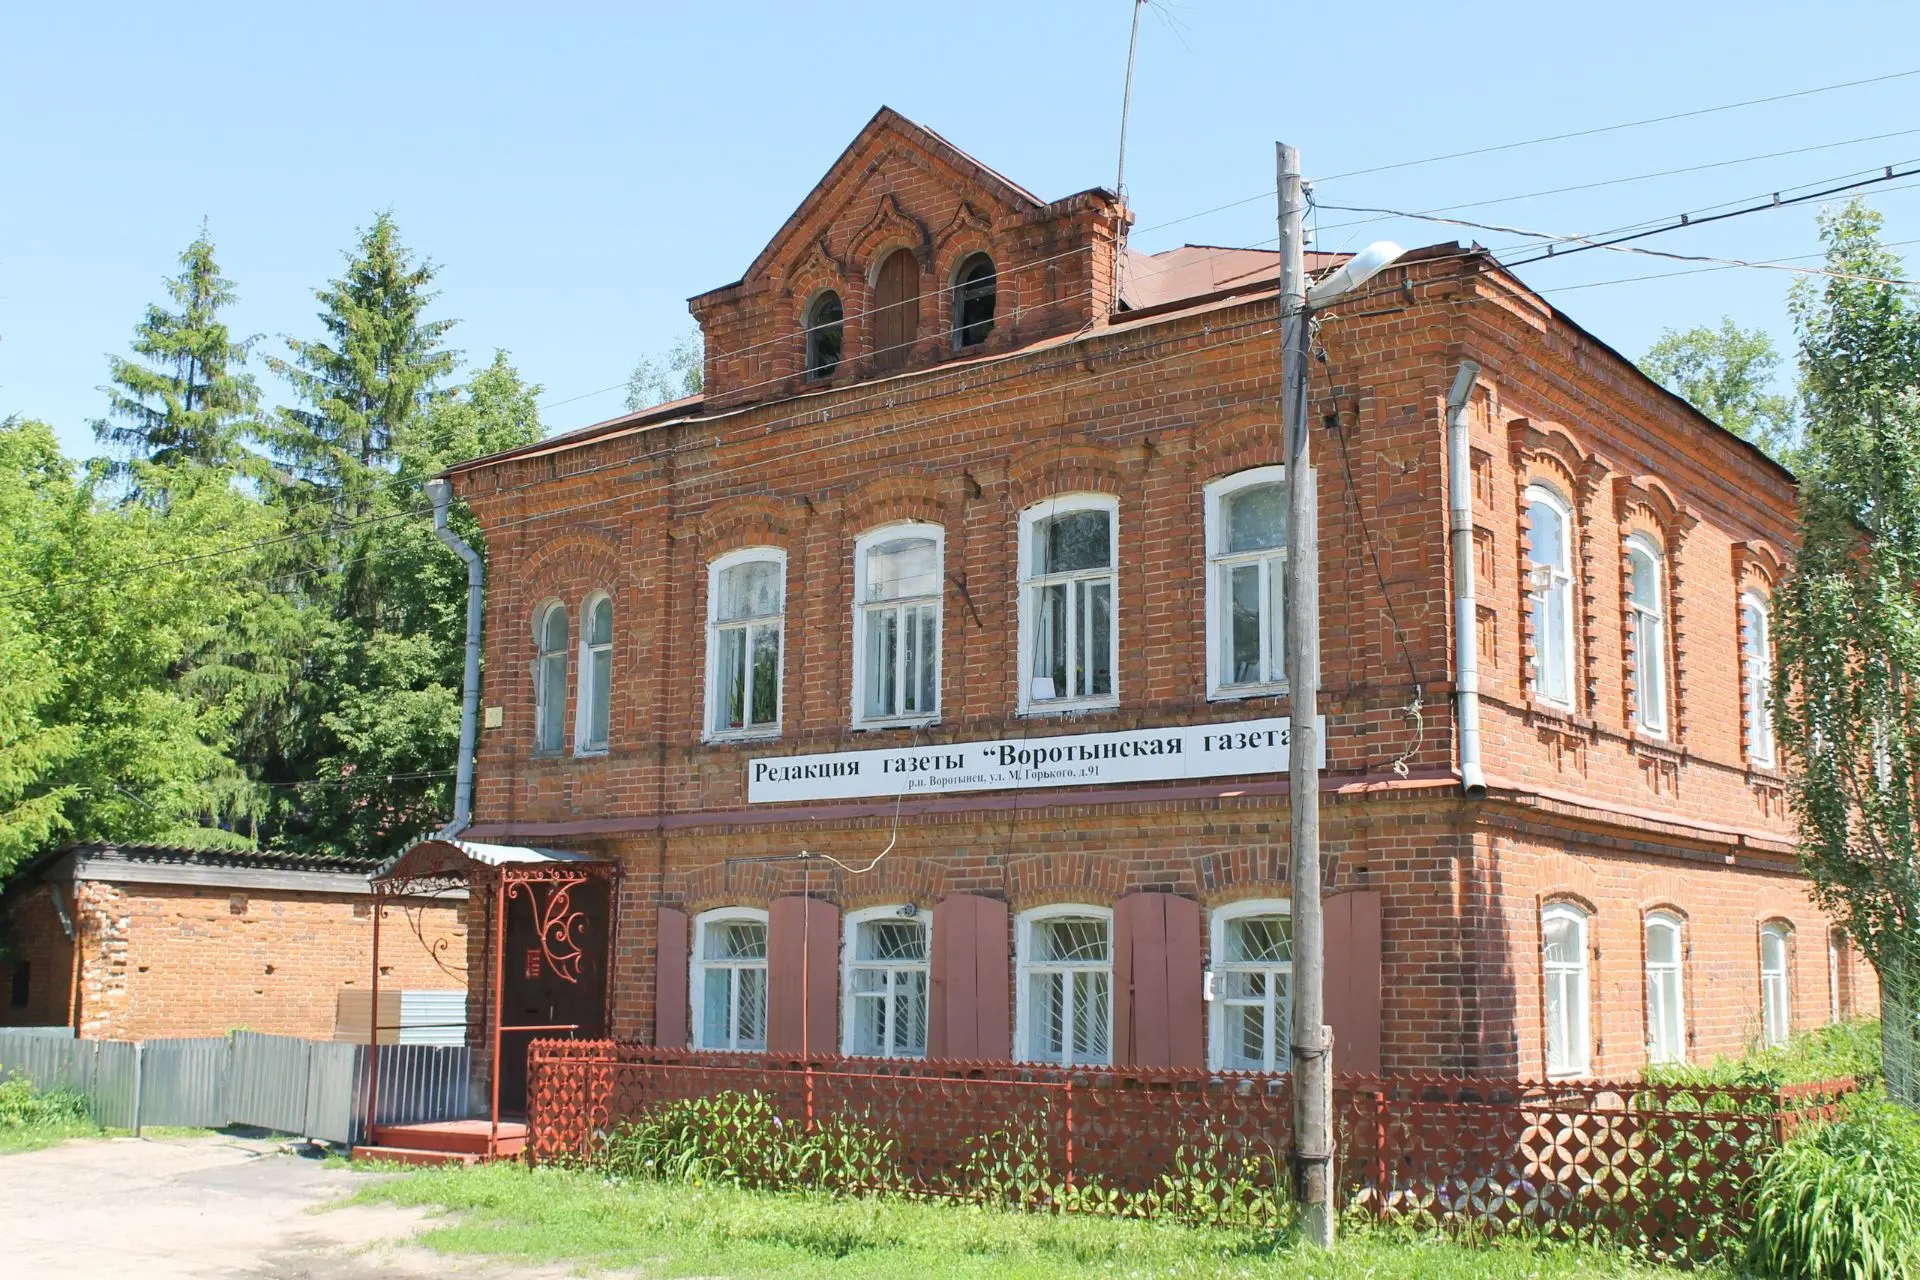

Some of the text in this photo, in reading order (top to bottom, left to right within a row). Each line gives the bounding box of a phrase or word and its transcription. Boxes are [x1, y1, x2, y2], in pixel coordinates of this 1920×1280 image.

[755, 761, 860, 783] Редакция
[883, 754, 965, 773] газеты
[1204, 729, 1291, 752] газета
[908, 779, 926, 790] р.п.
[989, 773, 1005, 785] ул.
[1078, 765, 1099, 778] д.91
